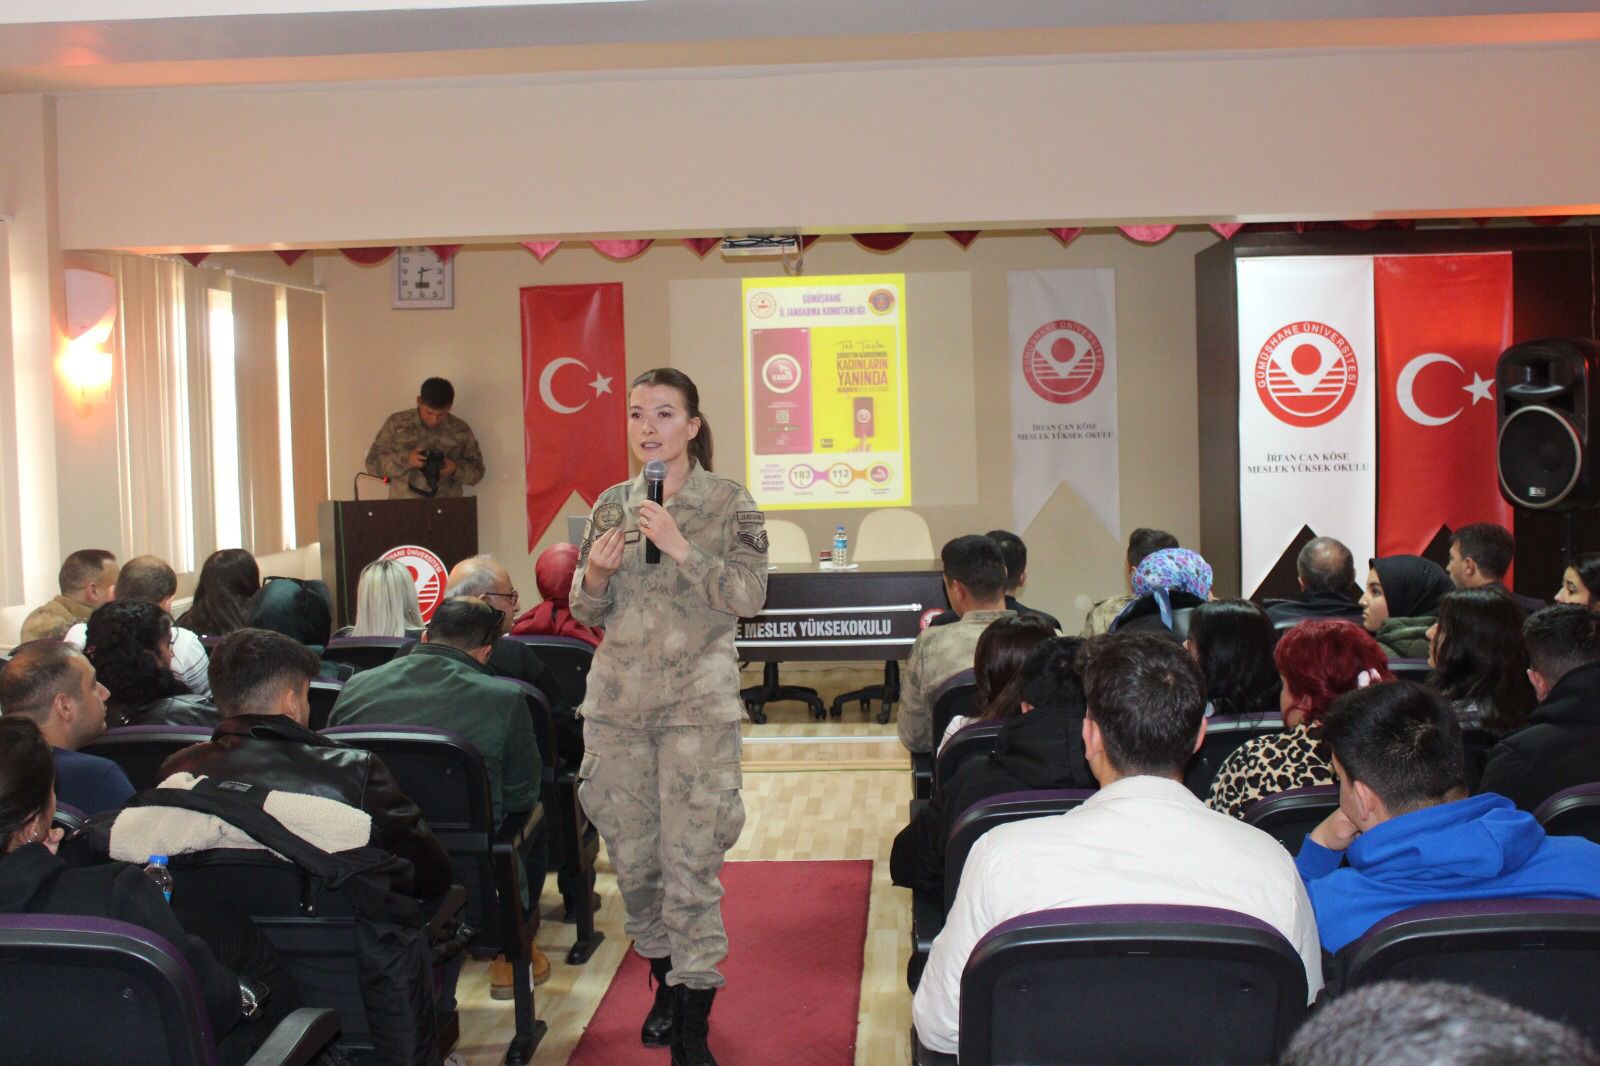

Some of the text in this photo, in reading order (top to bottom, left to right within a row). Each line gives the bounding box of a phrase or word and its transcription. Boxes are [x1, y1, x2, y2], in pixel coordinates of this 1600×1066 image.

[1255, 322, 1357, 388] GÜMÜŞHANE ÜNİVERSİTESİ
[837, 358, 888, 370] KADINLARIN
[838, 370, 888, 386] YANINDA
[1267, 450, 1350, 463] İRFAN CAN KÖSE
[832, 469, 850, 479] 112
[1247, 462, 1369, 474] MESLEK YÜKSEK OKULU
[793, 470, 812, 480] 183
[745, 621, 797, 639] MESLEK
[799, 617, 892, 638] YÜKSEKOKULU
